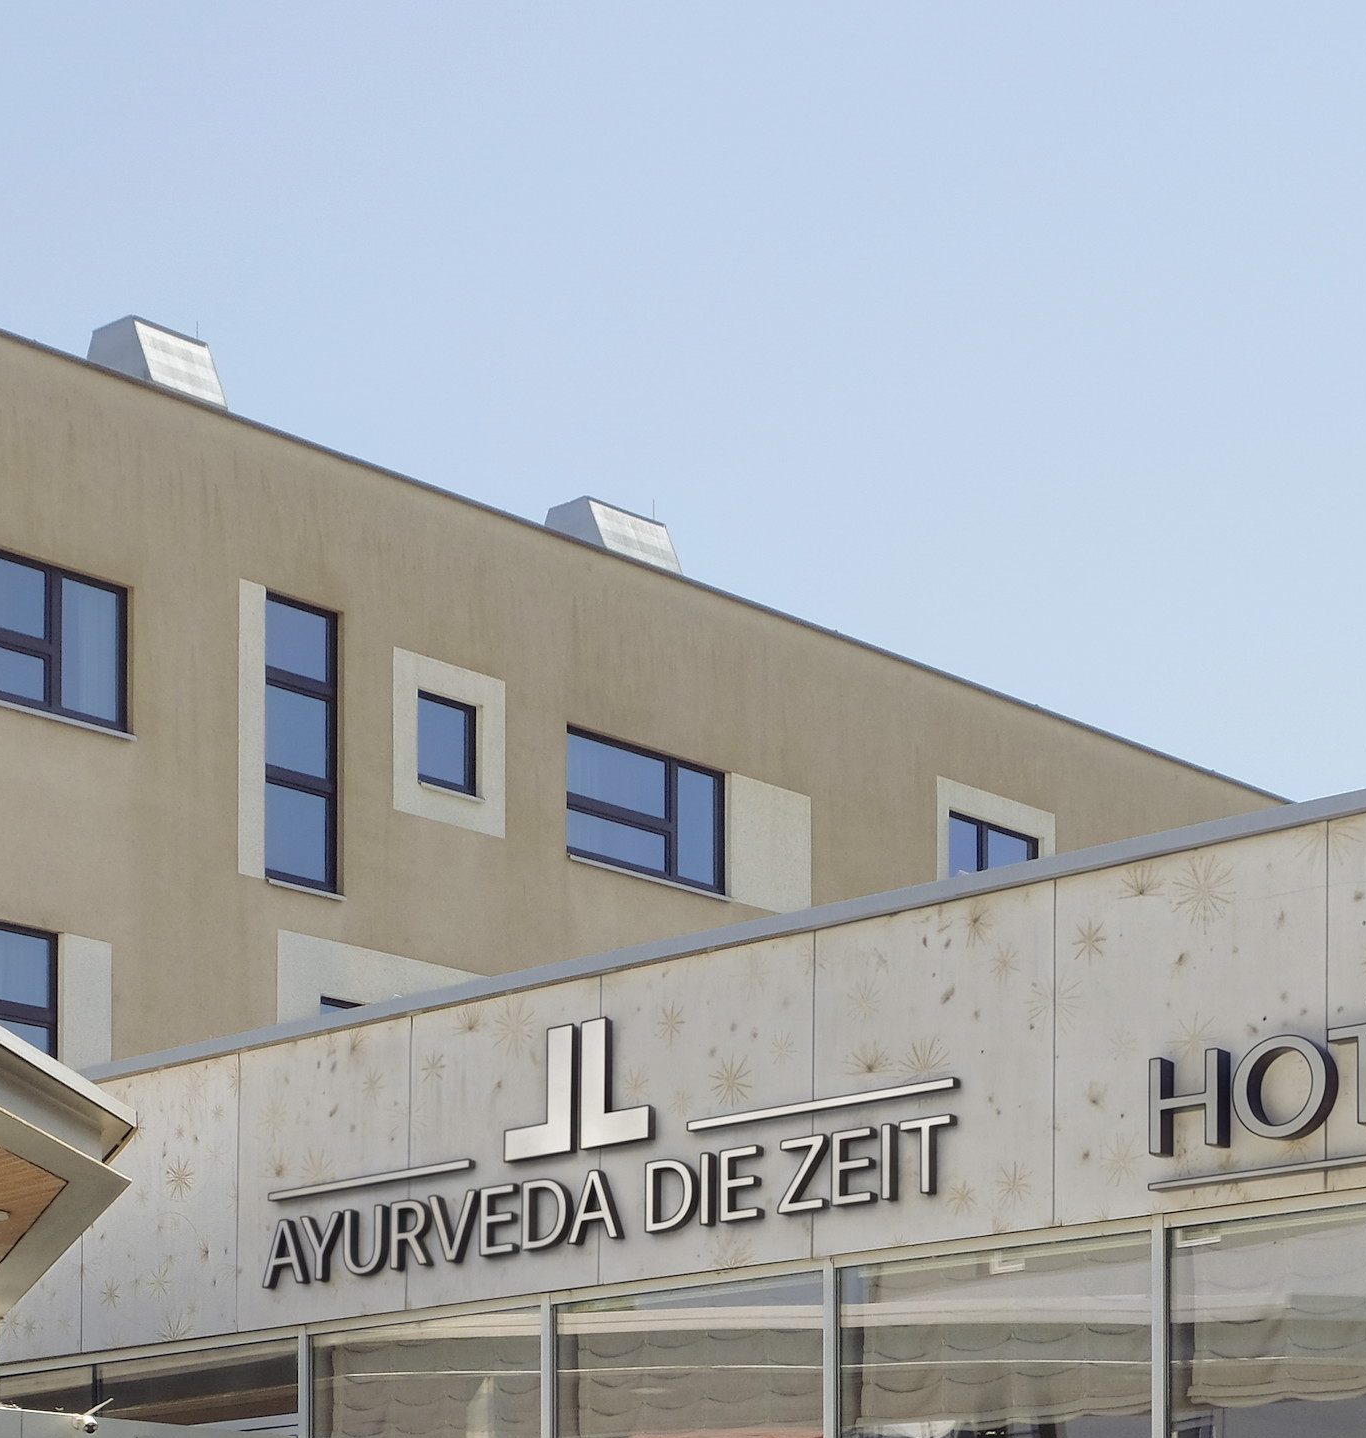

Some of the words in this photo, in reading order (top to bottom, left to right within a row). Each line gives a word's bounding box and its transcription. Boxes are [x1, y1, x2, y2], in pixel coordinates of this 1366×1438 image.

[262, 1168, 625, 1290] AYURVEDA
[644, 1143, 765, 1234] DIE
[777, 1112, 958, 1217] ZEIT
